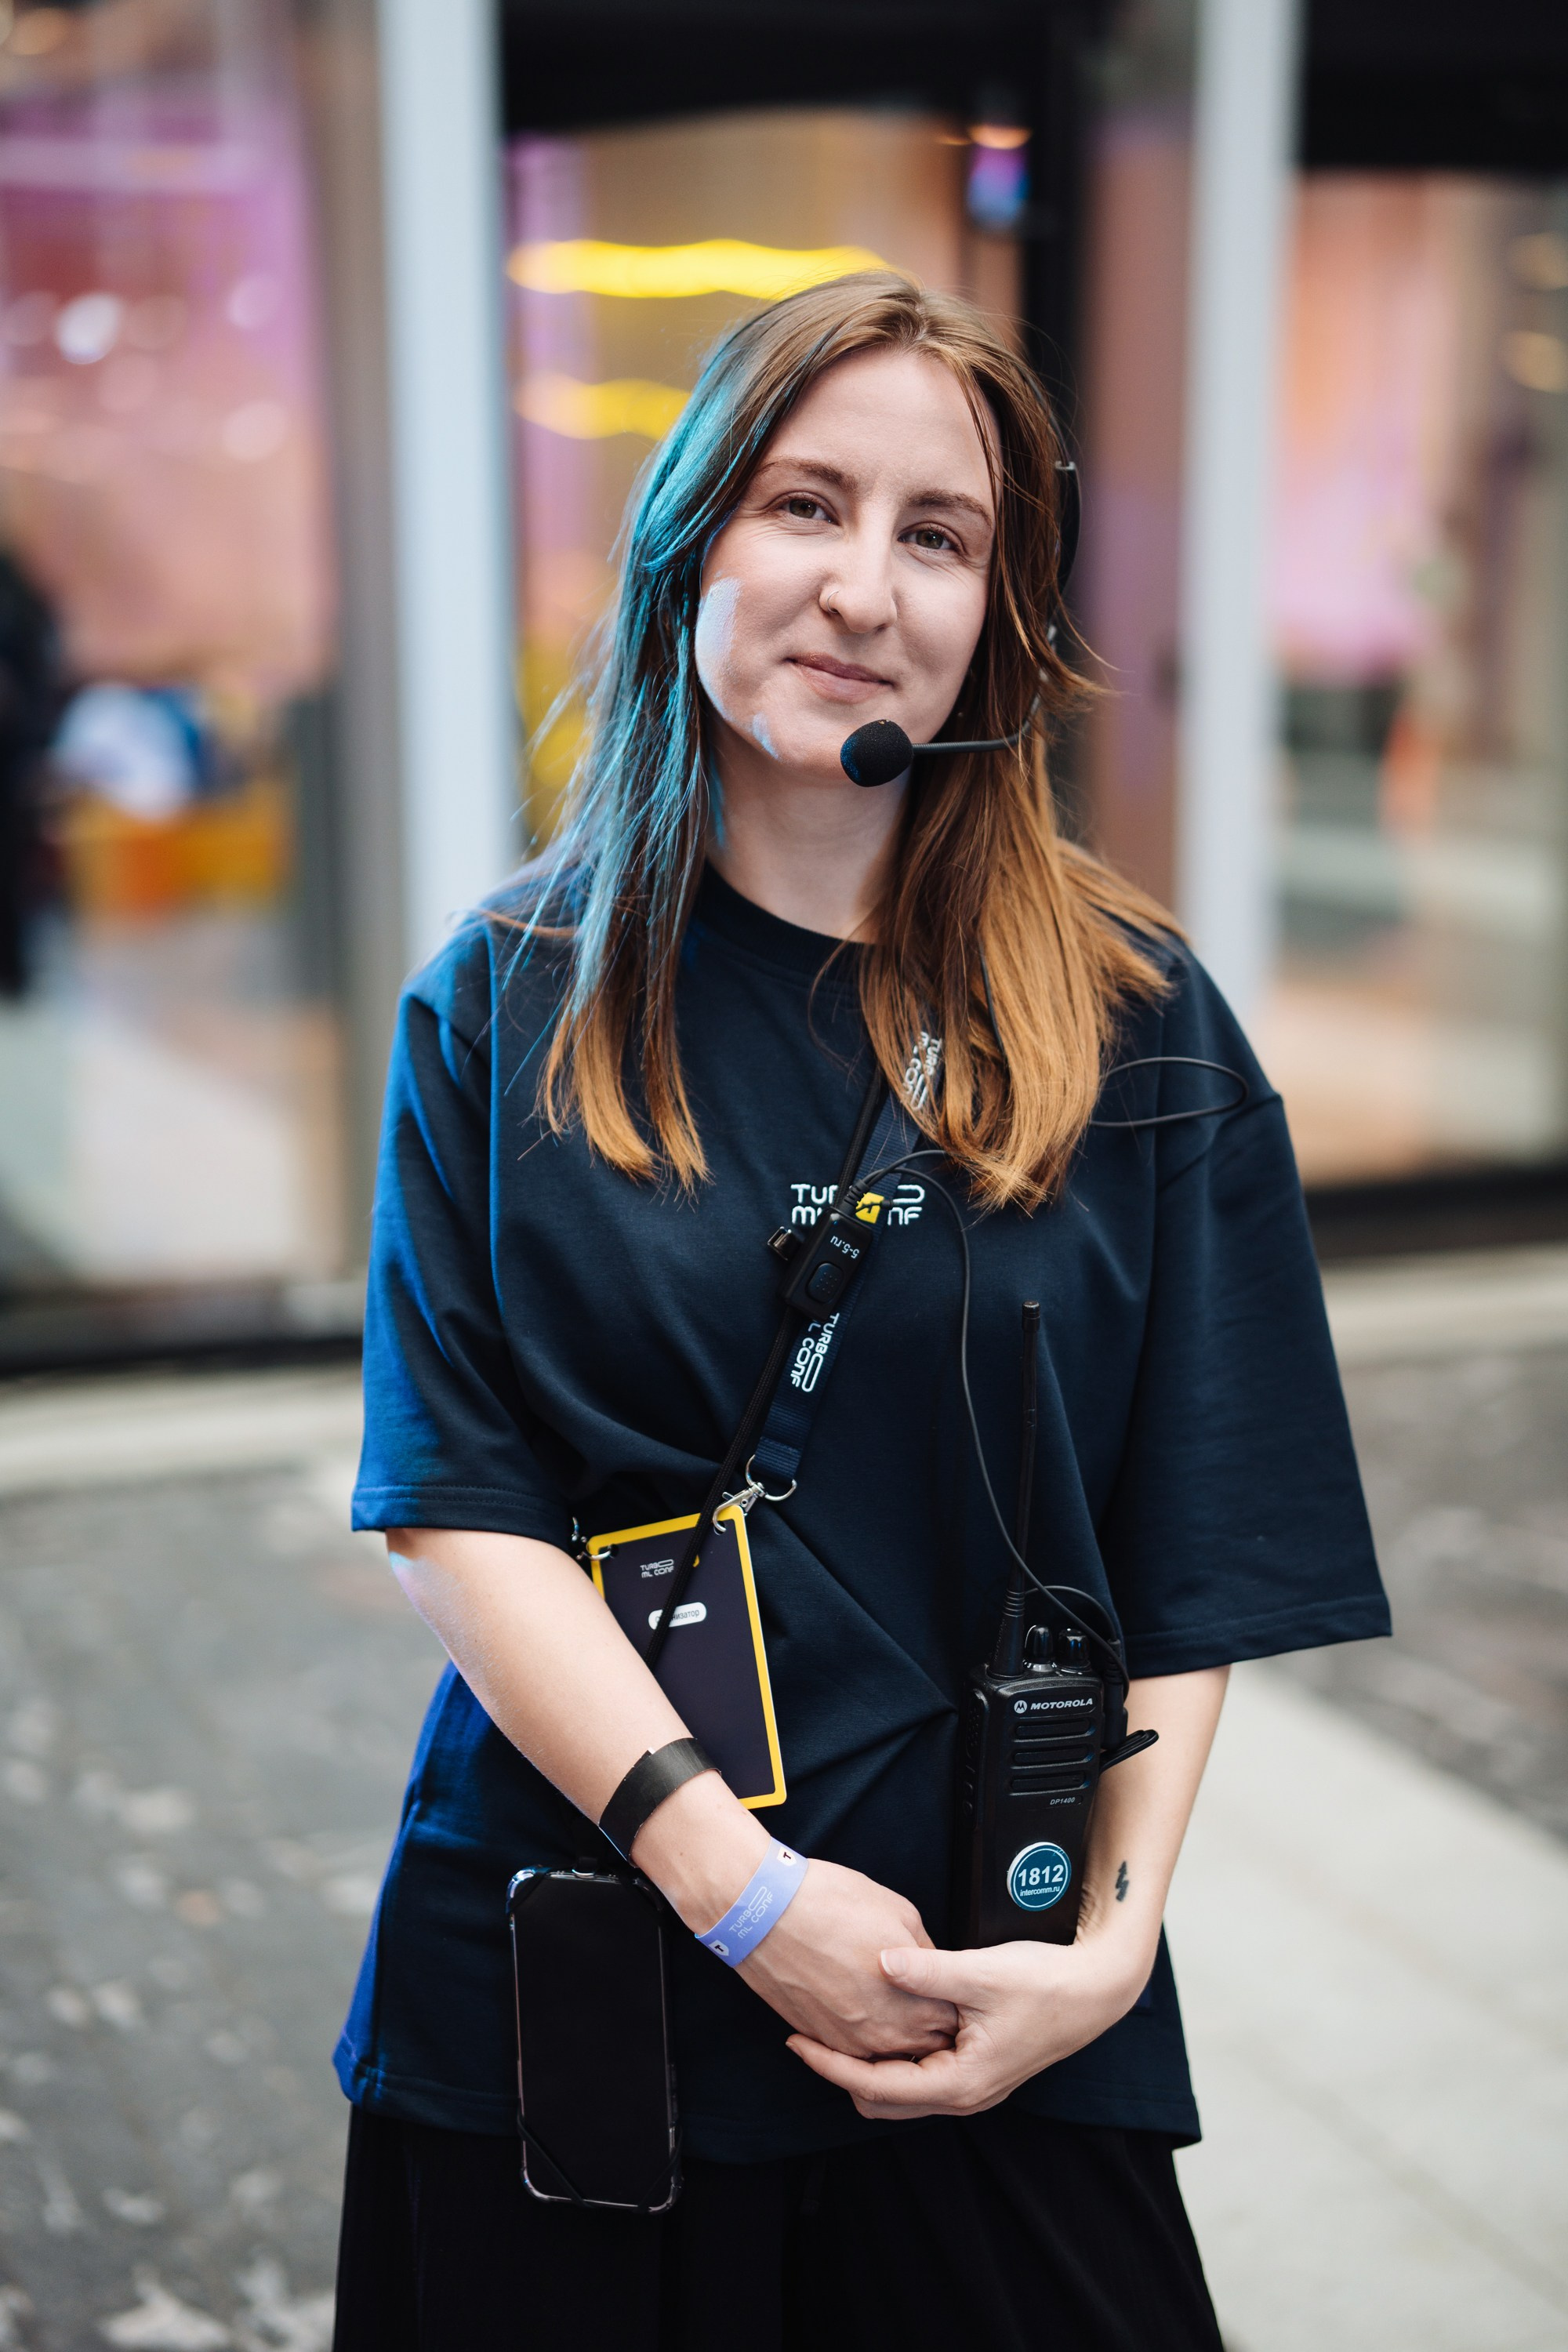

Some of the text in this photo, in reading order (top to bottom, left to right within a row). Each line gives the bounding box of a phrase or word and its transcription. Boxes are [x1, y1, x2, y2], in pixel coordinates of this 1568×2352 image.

[830, 1235, 860, 1259] 5-5.ru
[790, 1338, 815, 1388] CONF
[801, 1312, 840, 1392] TURBO
[640, 1559, 674, 1570] TURBO
[654, 1566, 674, 1576] CONF
[1030, 1698, 1093, 1710] MOTOROLA
[1050, 1797, 1076, 1806] DP1400
[1018, 1864, 1065, 1887] 1812
[1020, 1886, 1061, 1897] intercomm.ru
[728, 1886, 768, 1933] TURBO
[737, 1891, 774, 1939] ML CONF
